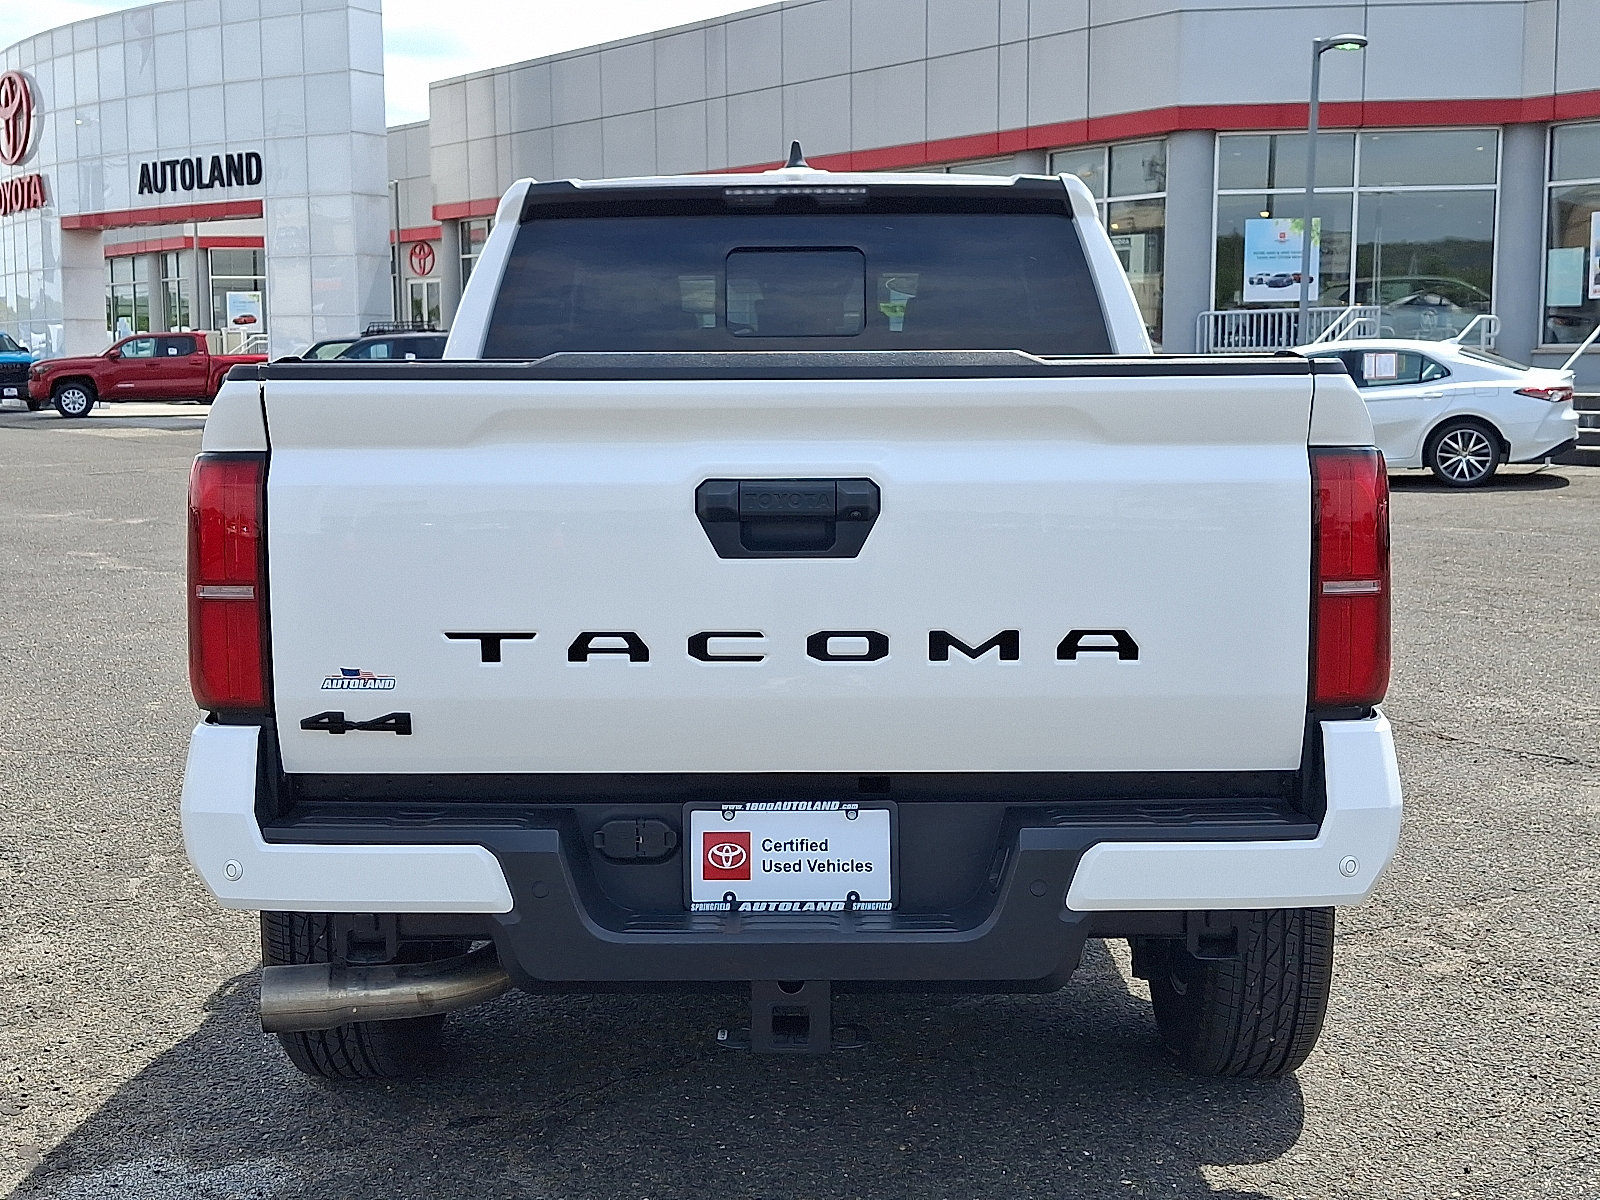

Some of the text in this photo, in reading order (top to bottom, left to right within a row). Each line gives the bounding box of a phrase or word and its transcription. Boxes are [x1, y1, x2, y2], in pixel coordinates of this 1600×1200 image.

[138, 152, 263, 195] AUTOLAND
[744, 493, 832, 509] TOYOTA
[443, 629, 1140, 663] TACOMA
[321, 678, 396, 690] AUTOLAND
[761, 838, 829, 853] Certified
[762, 859, 874, 873] Used Vehicles
[690, 902, 892, 912] SPRINGFIELD AUTOLAND SPRINGFIELD
